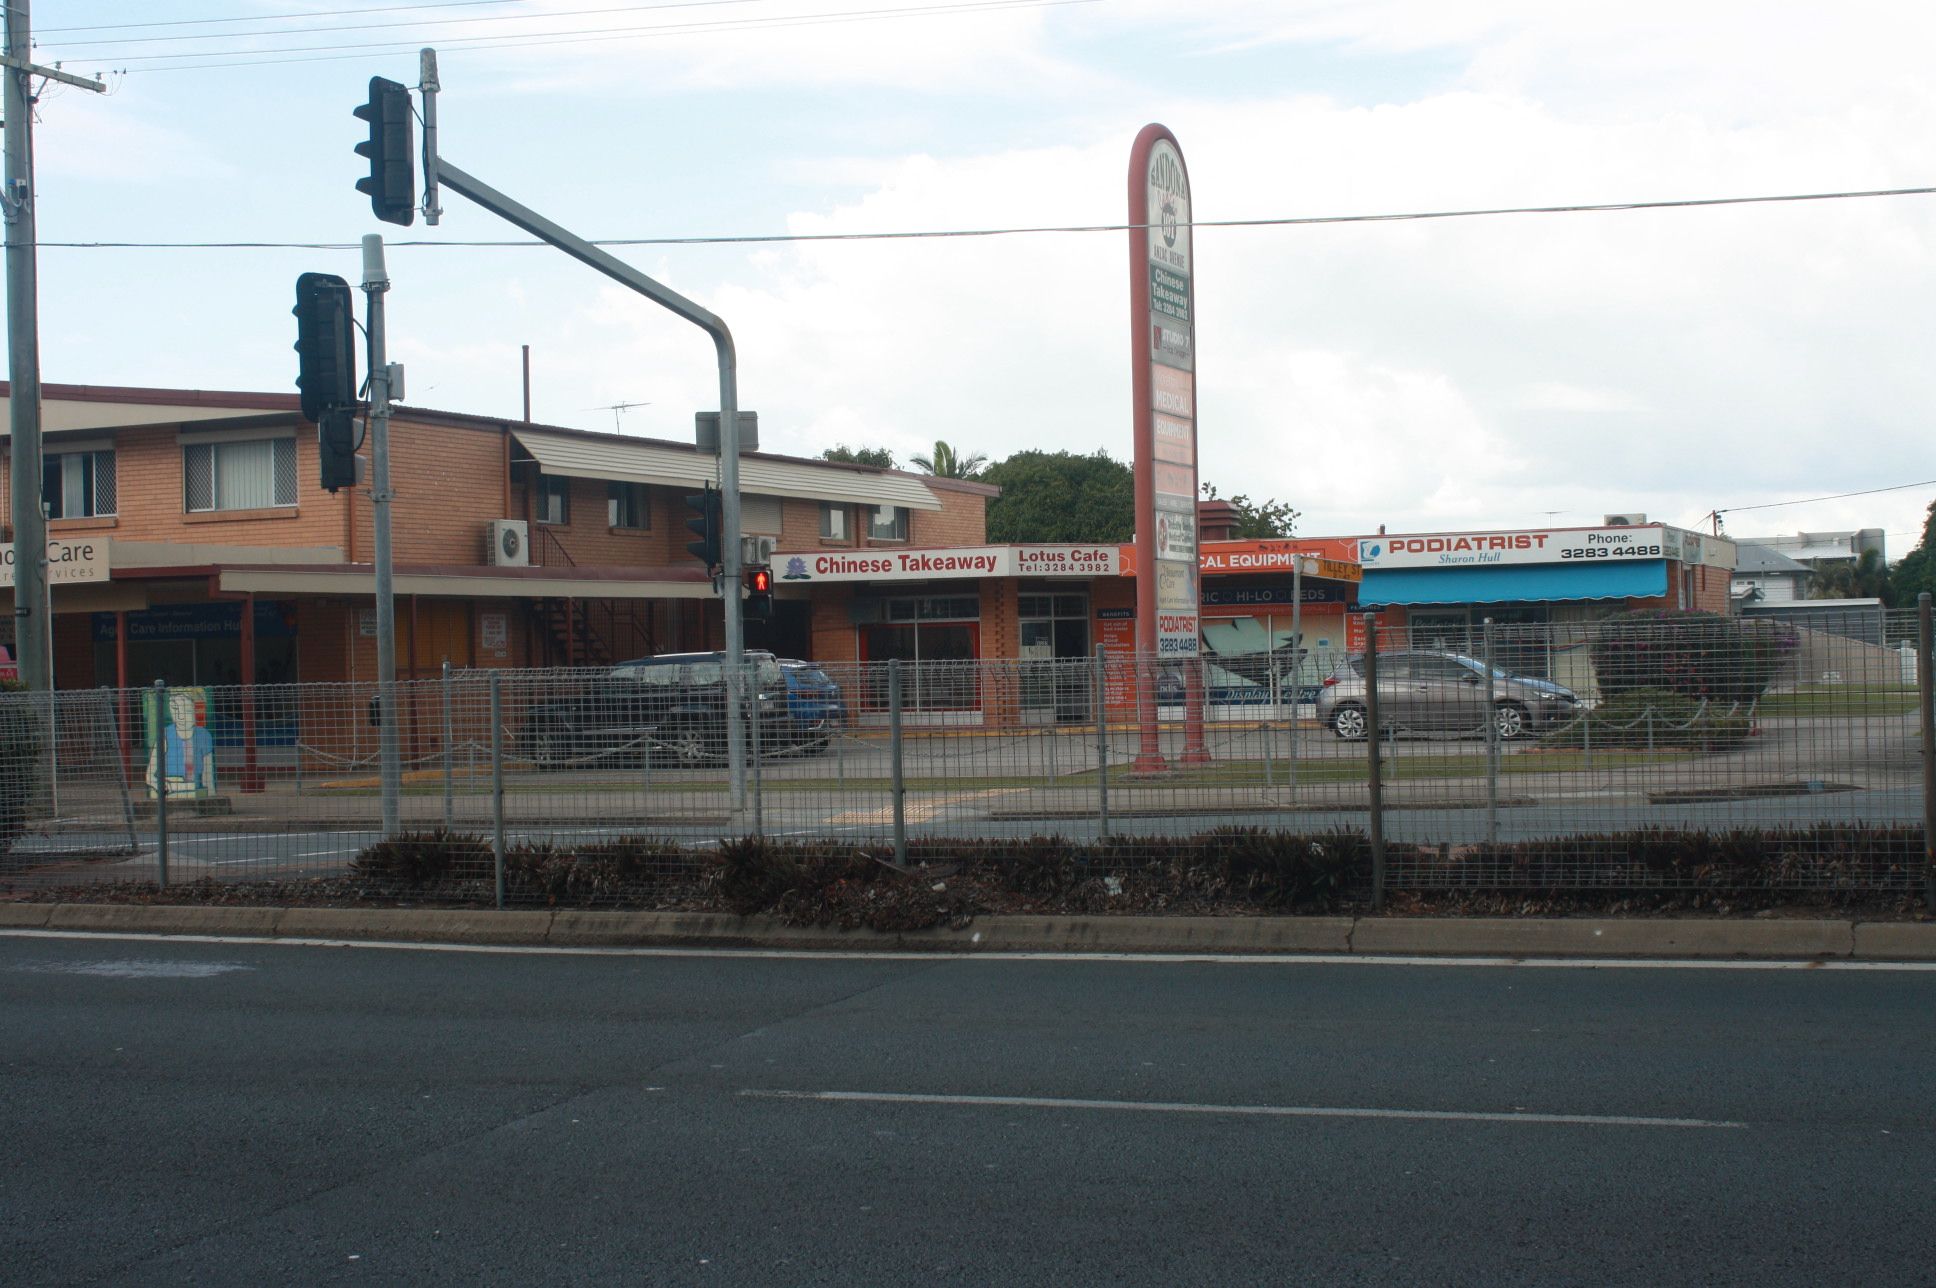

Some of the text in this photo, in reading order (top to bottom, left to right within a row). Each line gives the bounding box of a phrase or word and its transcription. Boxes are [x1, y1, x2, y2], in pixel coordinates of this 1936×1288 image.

[1163, 212, 1175, 239] 107
[1170, 250, 1185, 269] AVENUE
[1155, 268, 1184, 291] Chinese
[1152, 282, 1188, 309] Takeaway
[1156, 389, 1189, 413] MEDICAL
[1157, 417, 1189, 441] EQUIPMENT
[49, 542, 94, 563] Care
[1389, 533, 1633, 554] PODIATRIST Phone:
[815, 554, 997, 575] Chinese Takeaway
[1018, 549, 1109, 562] Lotus Cafe
[1438, 545, 1660, 564] Sharon Hull 3283 4488
[1080, 563, 1110, 572] 3982
[1236, 590, 1272, 602] HI-LO
[1291, 589, 1326, 600] EDS
[130, 623, 156, 634] Care
[158, 621, 221, 634] Information
[1159, 615, 1197, 632] PODIATRIST
[1160, 637, 1197, 652] 3283 4488
